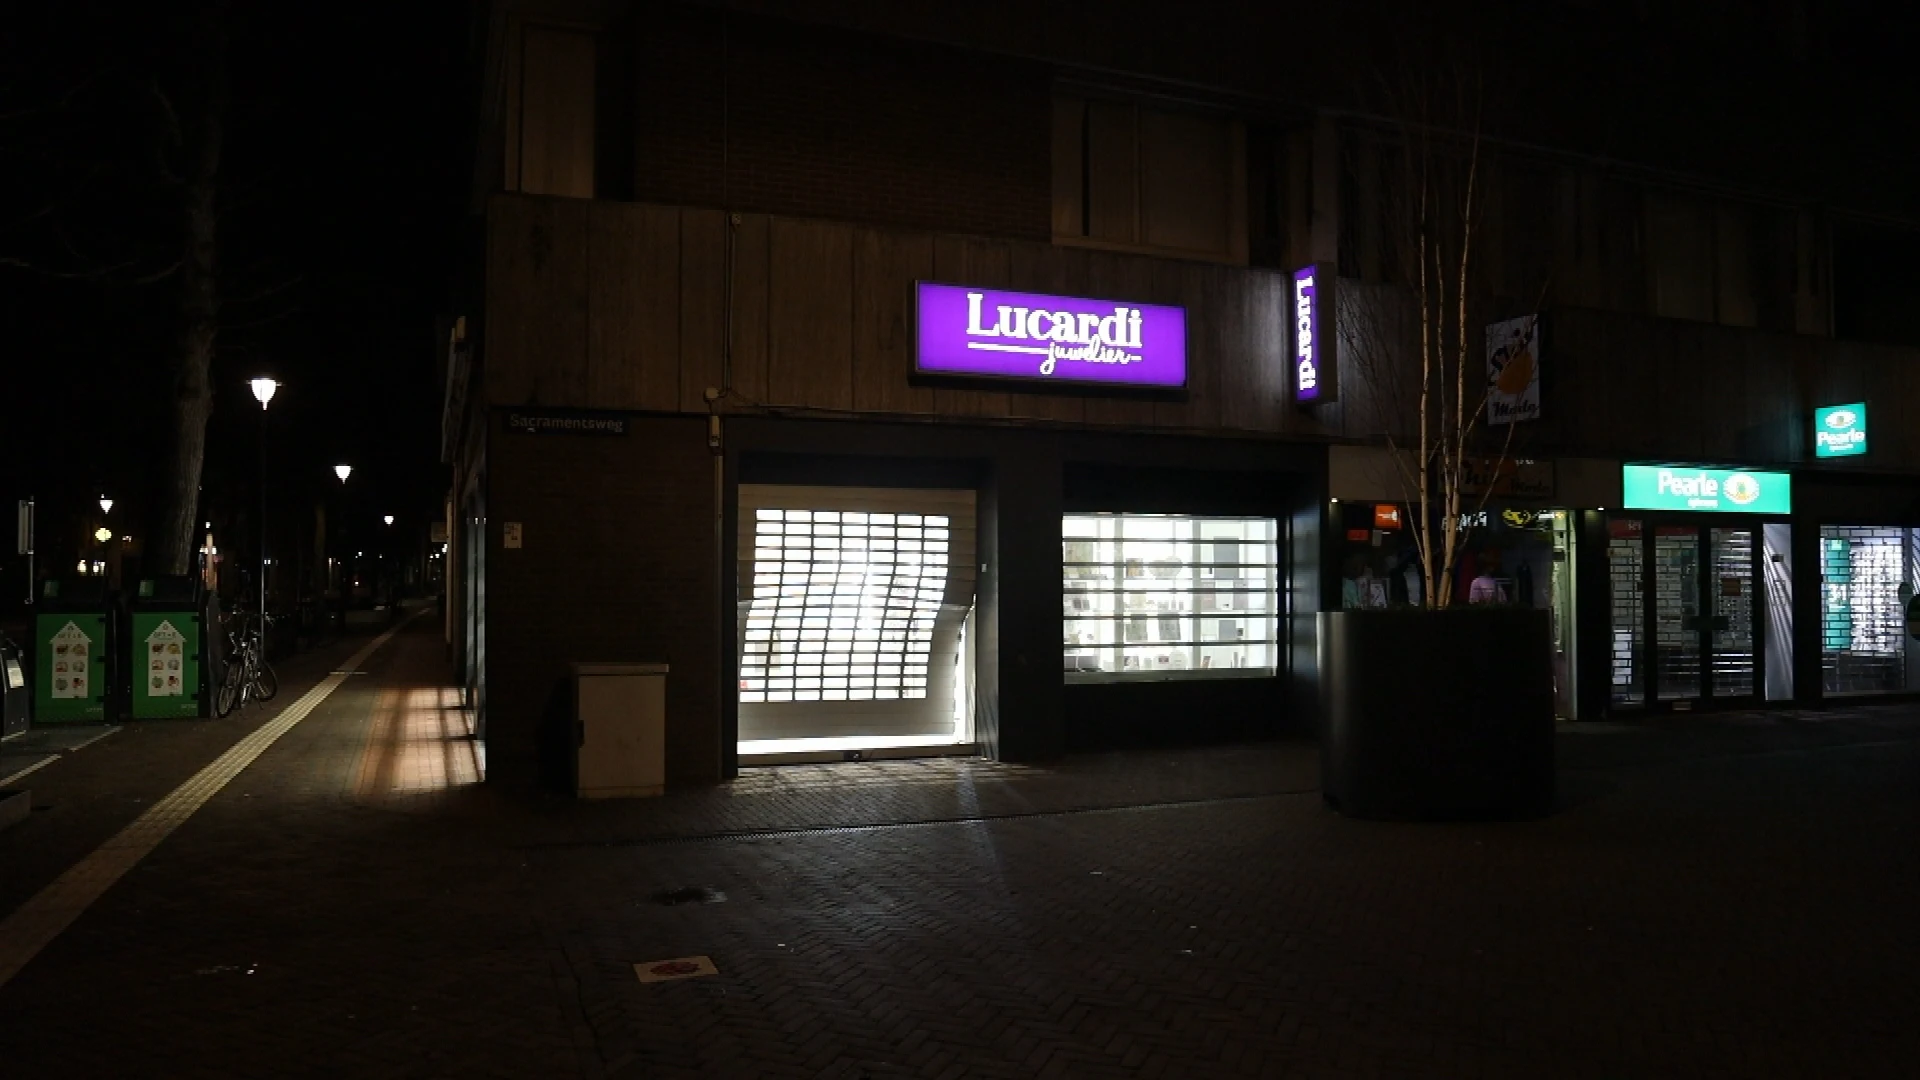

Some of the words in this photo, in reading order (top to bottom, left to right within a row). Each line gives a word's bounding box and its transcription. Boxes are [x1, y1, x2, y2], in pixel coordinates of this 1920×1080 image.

[966, 292, 1143, 349] Lucardi
[1296, 276, 1316, 391] Lucardi
[1039, 334, 1131, 375] juwelier
[509, 413, 623, 433] Sacramentsweg
[1816, 427, 1866, 447] Pearle
[1657, 471, 1719, 497] Pearle
